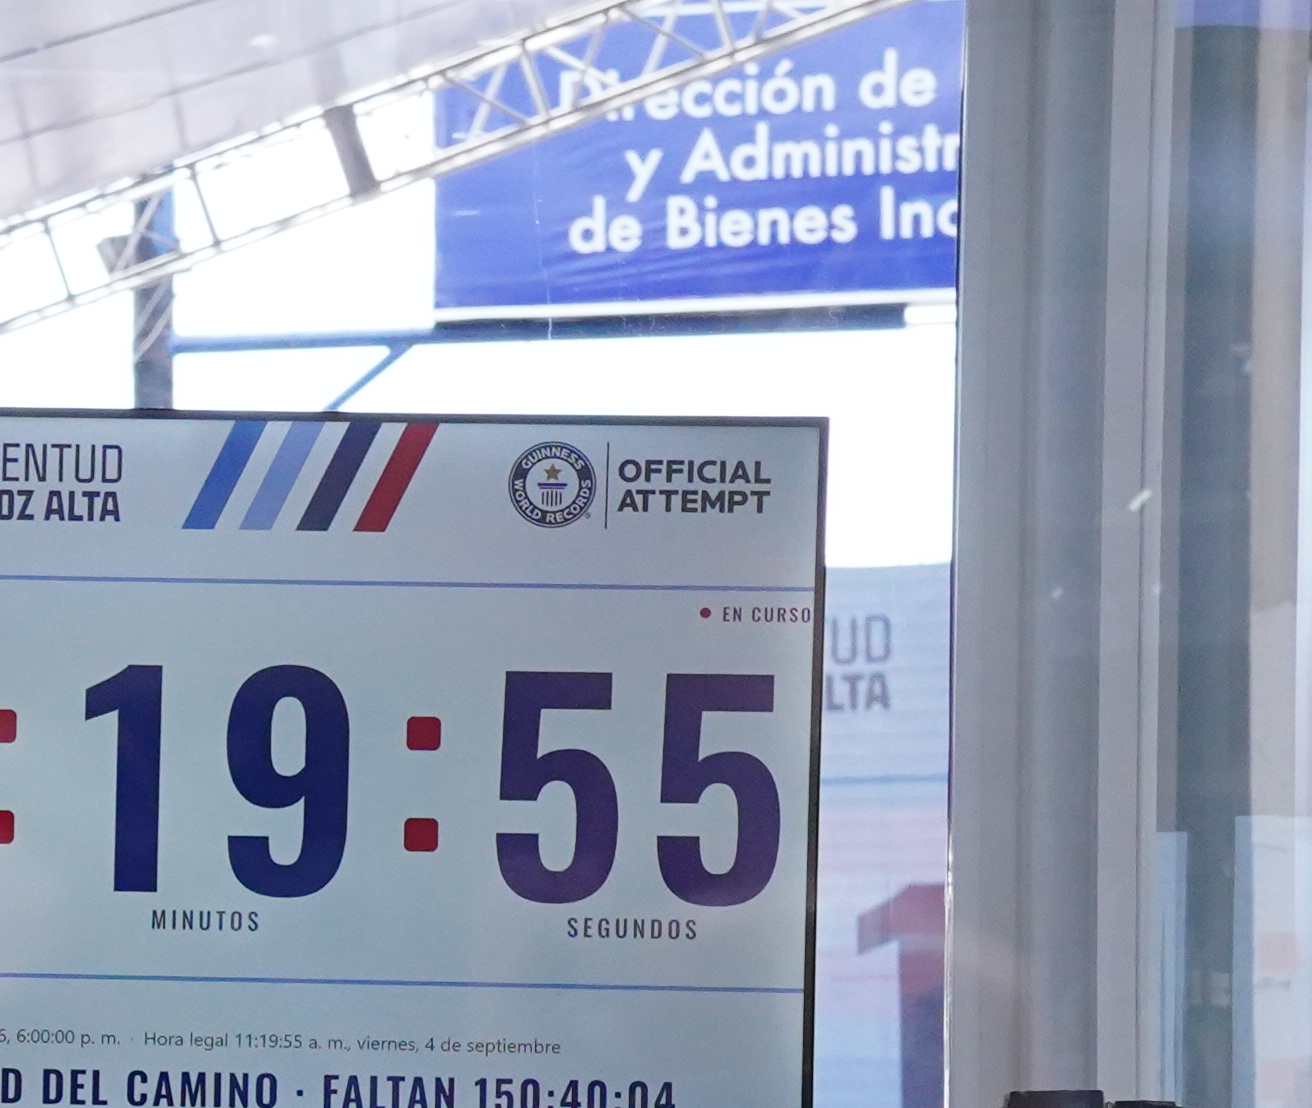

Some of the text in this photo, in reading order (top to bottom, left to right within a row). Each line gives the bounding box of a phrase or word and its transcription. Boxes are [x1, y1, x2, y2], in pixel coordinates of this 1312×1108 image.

[858, 47, 938, 109] de
[624, 120, 960, 203] y Administr
[568, 195, 643, 254] de
[666, 194, 858, 250] Bienes
[521, 445, 585, 471] GUINNESS
[617, 459, 772, 485] OFFICIAL
[43, 490, 122, 523] ALTA
[513, 478, 593, 525] WORLD RECORDS
[616, 489, 772, 514] ATTEMPT
[722, 606, 812, 624] EN CURSO
[830, 614, 892, 665] UD
[824, 671, 891, 711] LTA
[150, 908, 260, 933] MINUTOS
[566, 916, 699, 940] SEGUNDOS
[15, 1029, 75, 1044] 6:00:00
[80, 1034, 96, 1049] p.
[100, 1033, 121, 1046] m.
[143, 1032, 184, 1047] Hora
[189, 1032, 229, 1051] legal
[235, 1034, 303, 1050] 11:19:55
[308, 1038, 322, 1050] a.
[356, 1035, 419, 1053] viernes,
[424, 1037, 436, 1052] 4
[440, 1037, 461, 1052] de
[466, 1038, 561, 1057] septiembre
[41, 1068, 109, 1106] DEL
